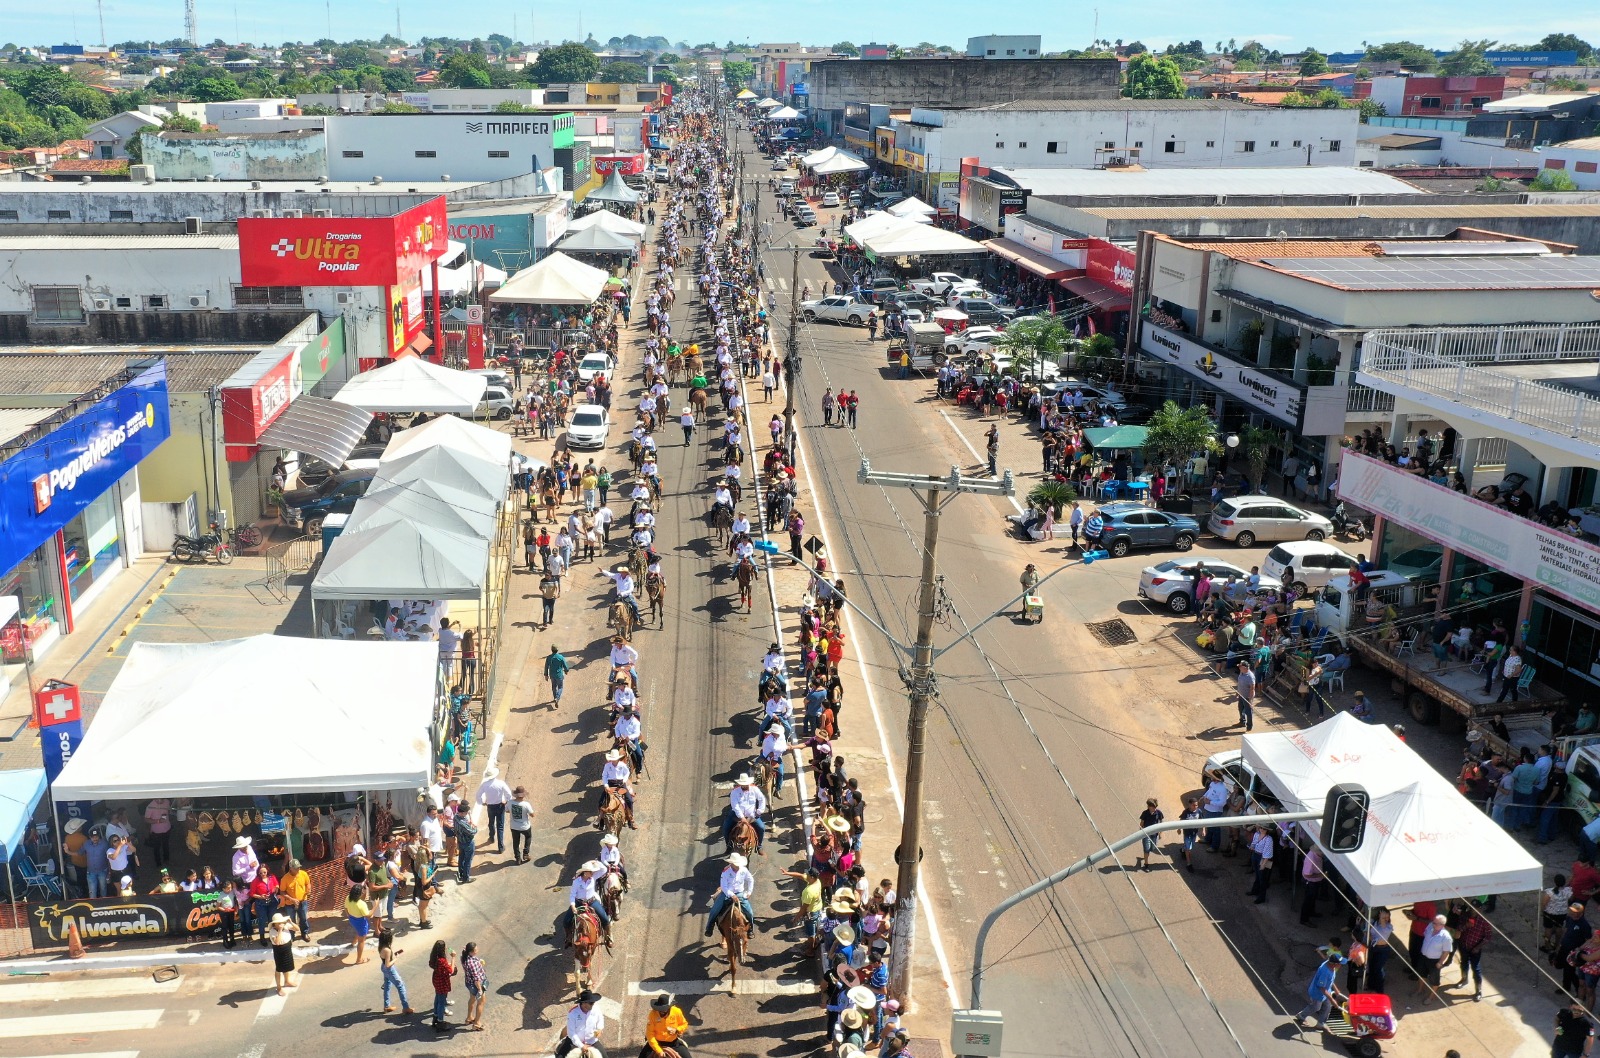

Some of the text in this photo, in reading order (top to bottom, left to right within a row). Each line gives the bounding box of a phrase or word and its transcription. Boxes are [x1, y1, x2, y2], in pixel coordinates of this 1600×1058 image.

[487, 122, 548, 134] MAPIFER
[326, 232, 362, 242] Drogarias
[294, 238, 360, 260] Ultra
[318, 261, 360, 273] Popular
[1535, 533, 1556, 547] TELHAS
[1557, 542, 1585, 559] BRASILIT
[1539, 544, 1564, 560] JANELAS
[1568, 555, 1590, 571] TINTAS
[1540, 554, 1573, 573] MATERIAIS
[91, 908, 139, 918] COMITIVA
[60, 914, 160, 940] Alvorada
